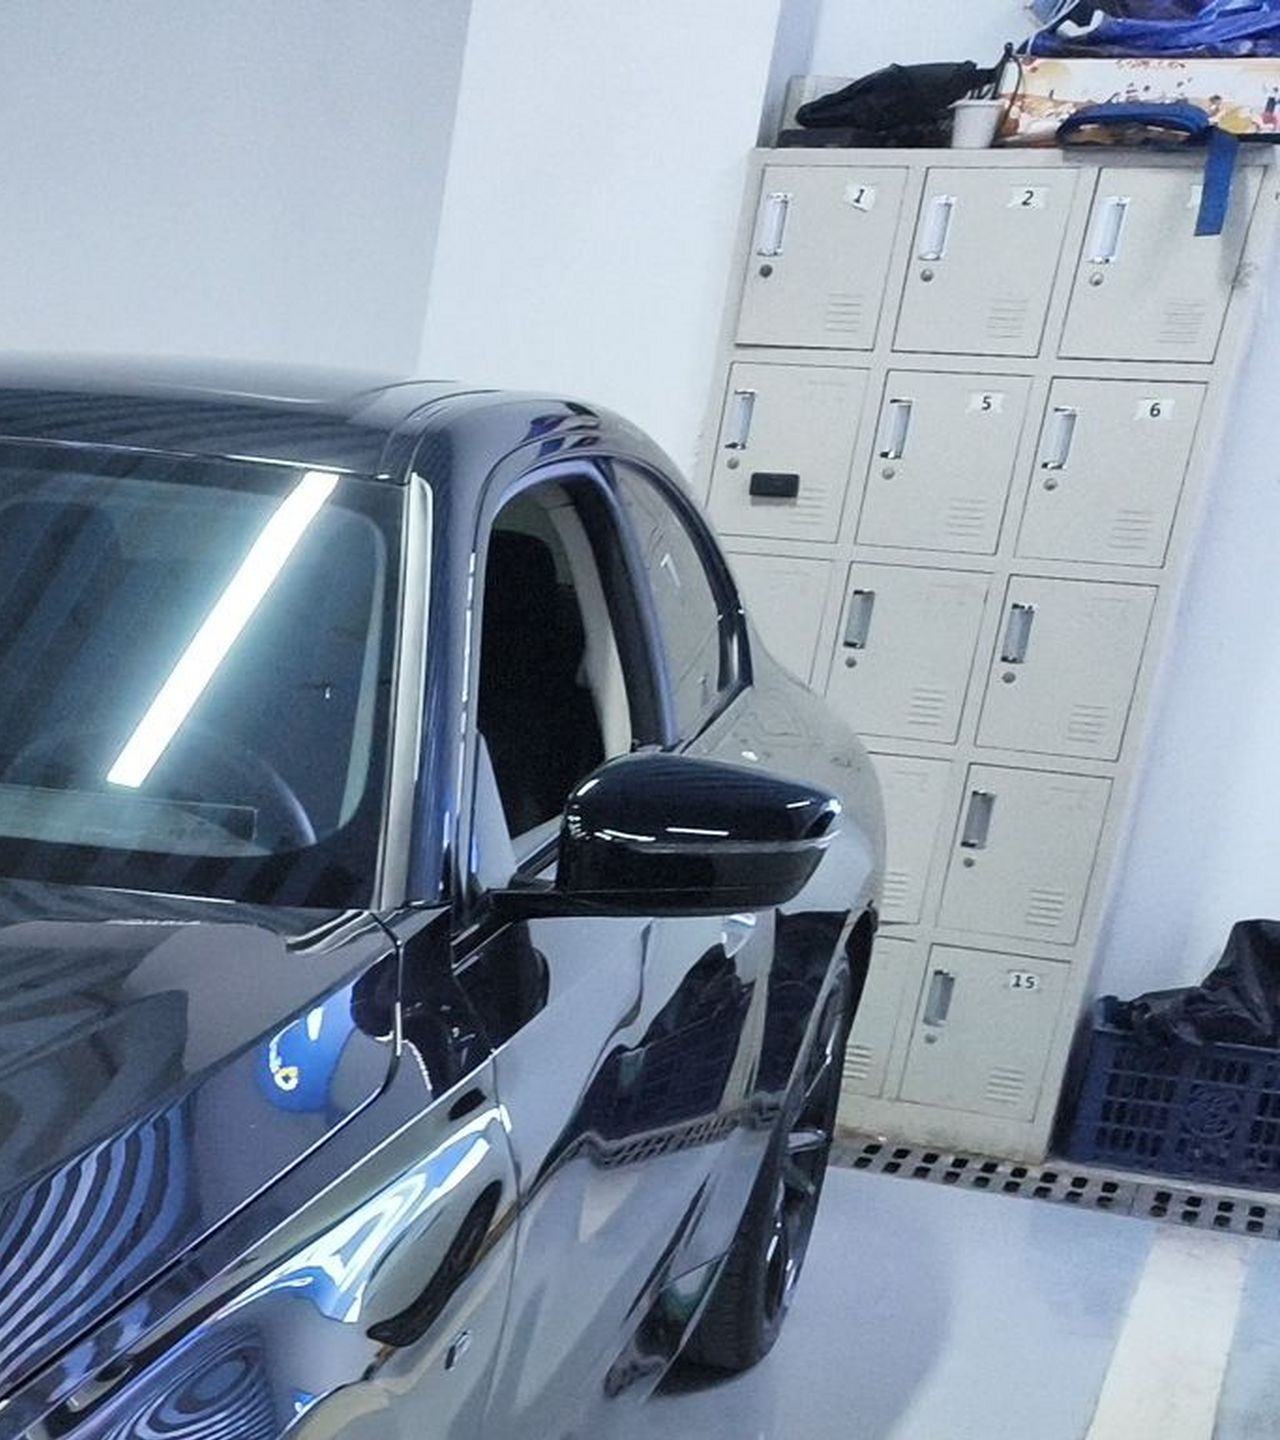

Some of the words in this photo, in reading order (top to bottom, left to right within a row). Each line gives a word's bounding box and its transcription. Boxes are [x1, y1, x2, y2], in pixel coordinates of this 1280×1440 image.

[853, 188, 865, 204] 1
[1021, 190, 1034, 206] 2
[981, 395, 992, 411] 5
[1149, 402, 1161, 418] 6
[1012, 974, 1035, 989] 15
